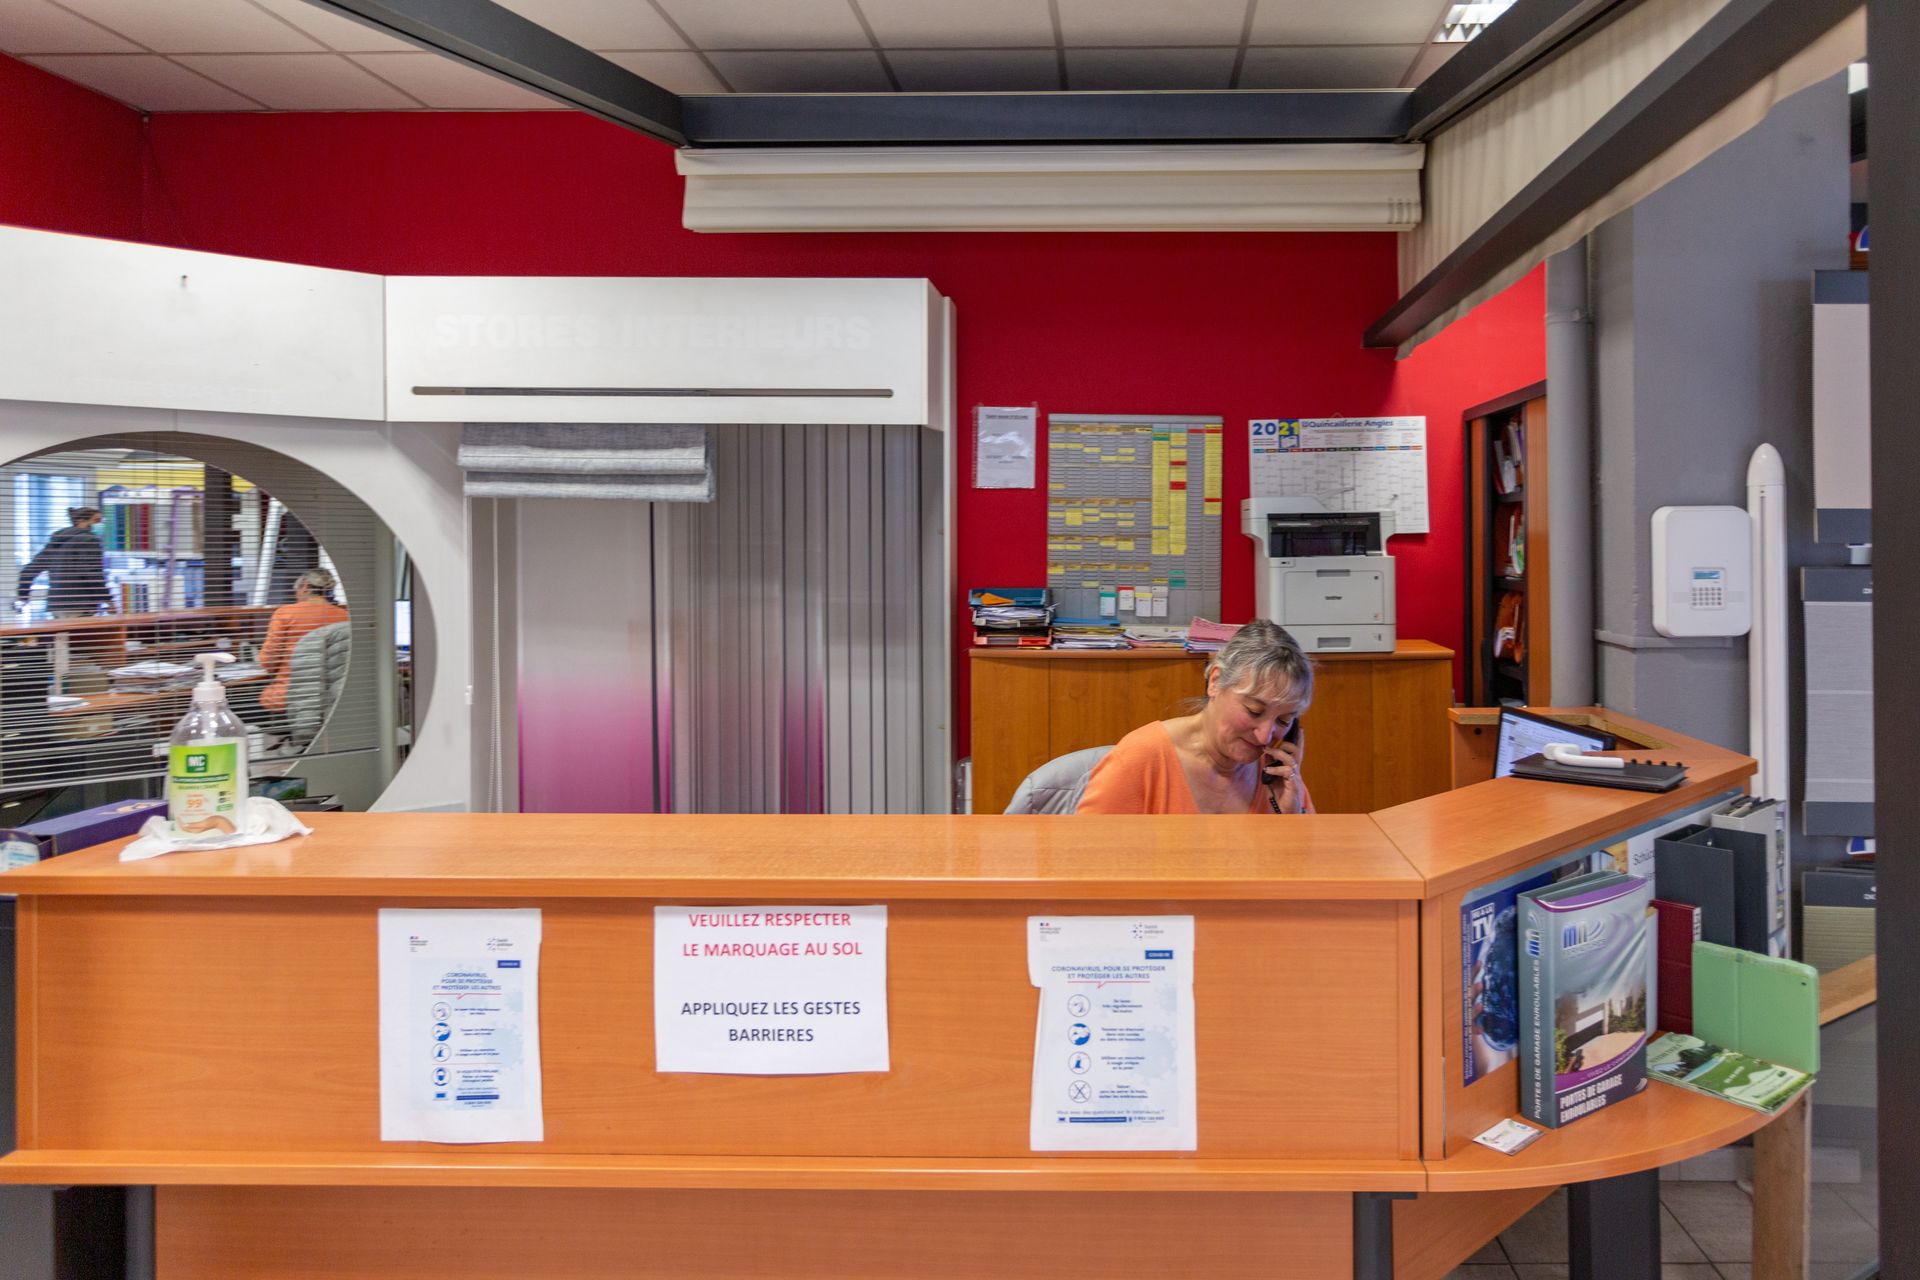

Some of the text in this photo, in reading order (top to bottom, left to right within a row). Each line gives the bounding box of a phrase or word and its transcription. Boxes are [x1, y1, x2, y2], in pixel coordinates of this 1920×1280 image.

[434, 313, 872, 350] STORES INTERIEURS
[688, 913, 851, 927] VEUILLEZ RESPECTER
[1472, 914, 1494, 940] TV
[683, 942, 863, 958] LE MARQUAGE AU SOL
[681, 1001, 861, 1017] APPLIQUEZ LES GESTES
[728, 1028, 814, 1042] BARRIERES
